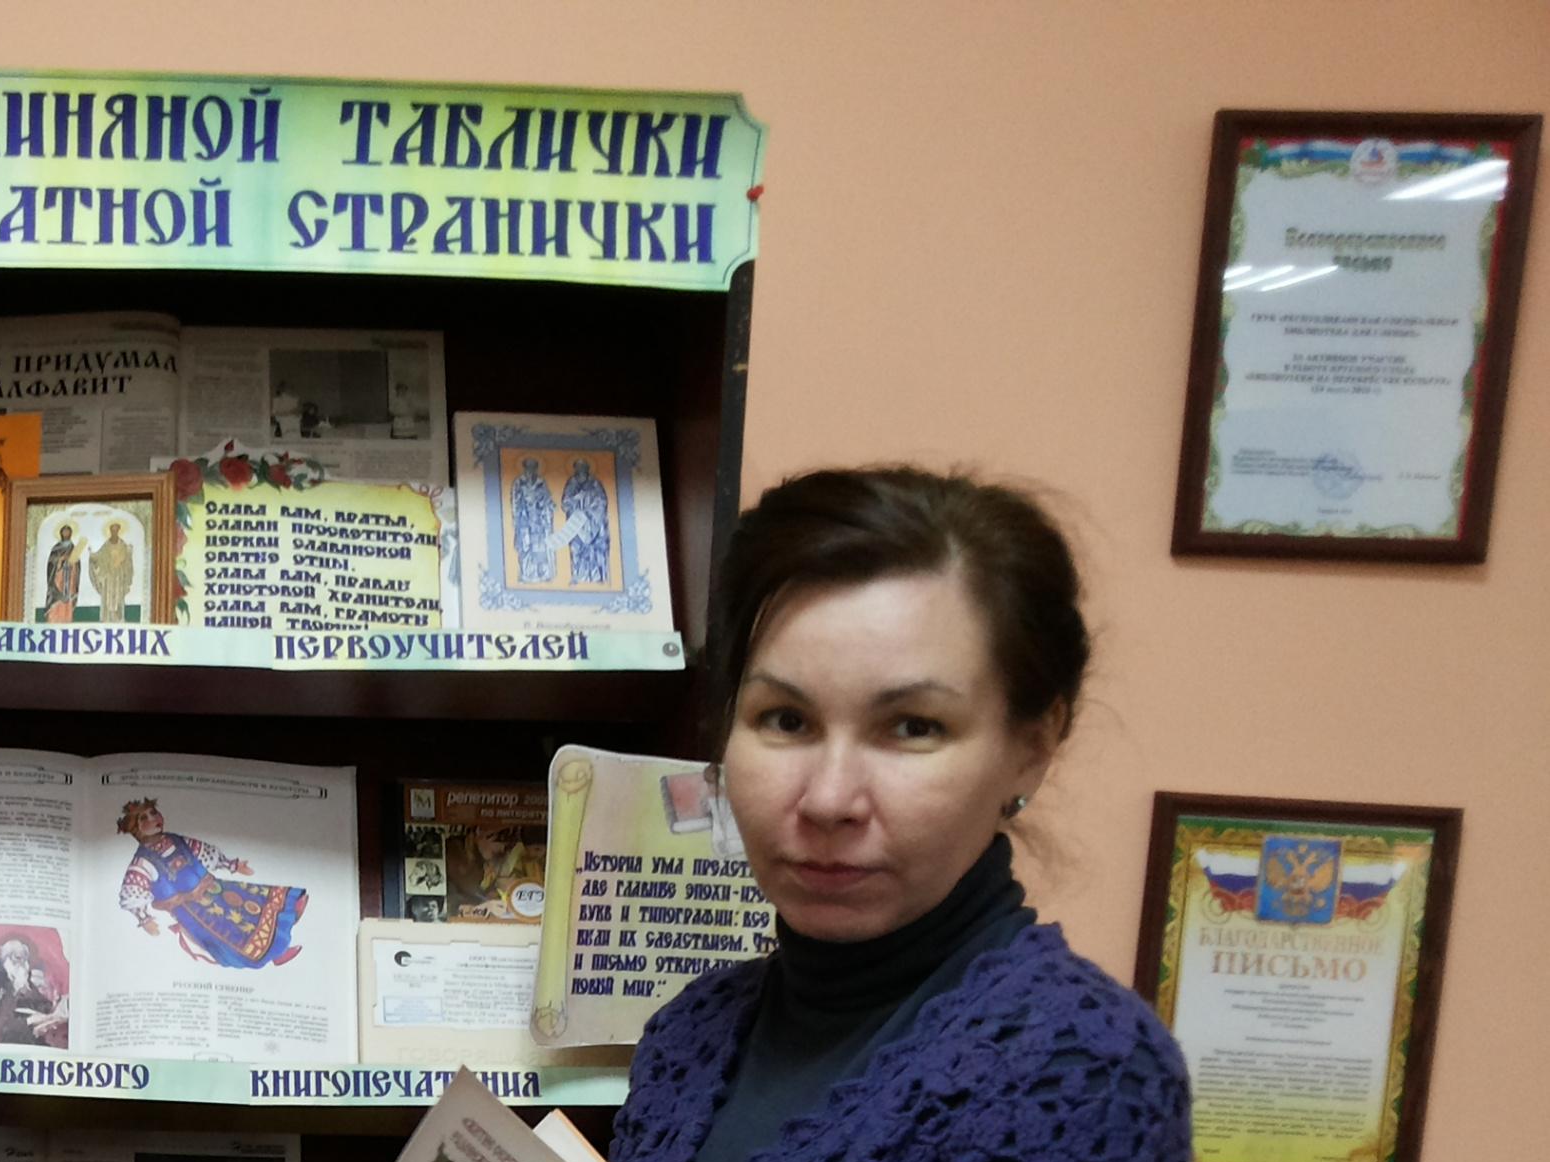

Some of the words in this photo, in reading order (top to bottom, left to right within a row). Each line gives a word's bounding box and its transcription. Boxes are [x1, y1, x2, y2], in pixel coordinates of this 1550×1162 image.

[339, 99, 731, 179] ТАБЛИЧКИ
[287, 189, 716, 264] СТРАНИЧКИ
[13, 349, 179, 375] ПРИДУМАЛ
[274, 631, 590, 661] ПЕРВОУЧИТЕЛЕЙ
[496, 810, 547, 820] литерату
[652, 857, 685, 876] УМА
[693, 859, 754, 879] ПРЕДСТ
[581, 880, 608, 897] ДВЕ
[615, 880, 677, 900] ГЛАВНЫЕ
[578, 905, 612, 922] БУКВ
[621, 905, 631, 922] И
[742, 911, 771, 929] ВСЕ
[576, 929, 612, 947] БЫЛИ
[619, 930, 637, 947] ИХ
[573, 953, 584, 970] И
[591, 954, 647, 973] ПИСЬМО
[1211, 951, 1368, 982] ПИСЬМО
[571, 977, 615, 995] НОВЫЙ
[251, 1068, 543, 1099] КНИГОПЕЧАТНИЯ
